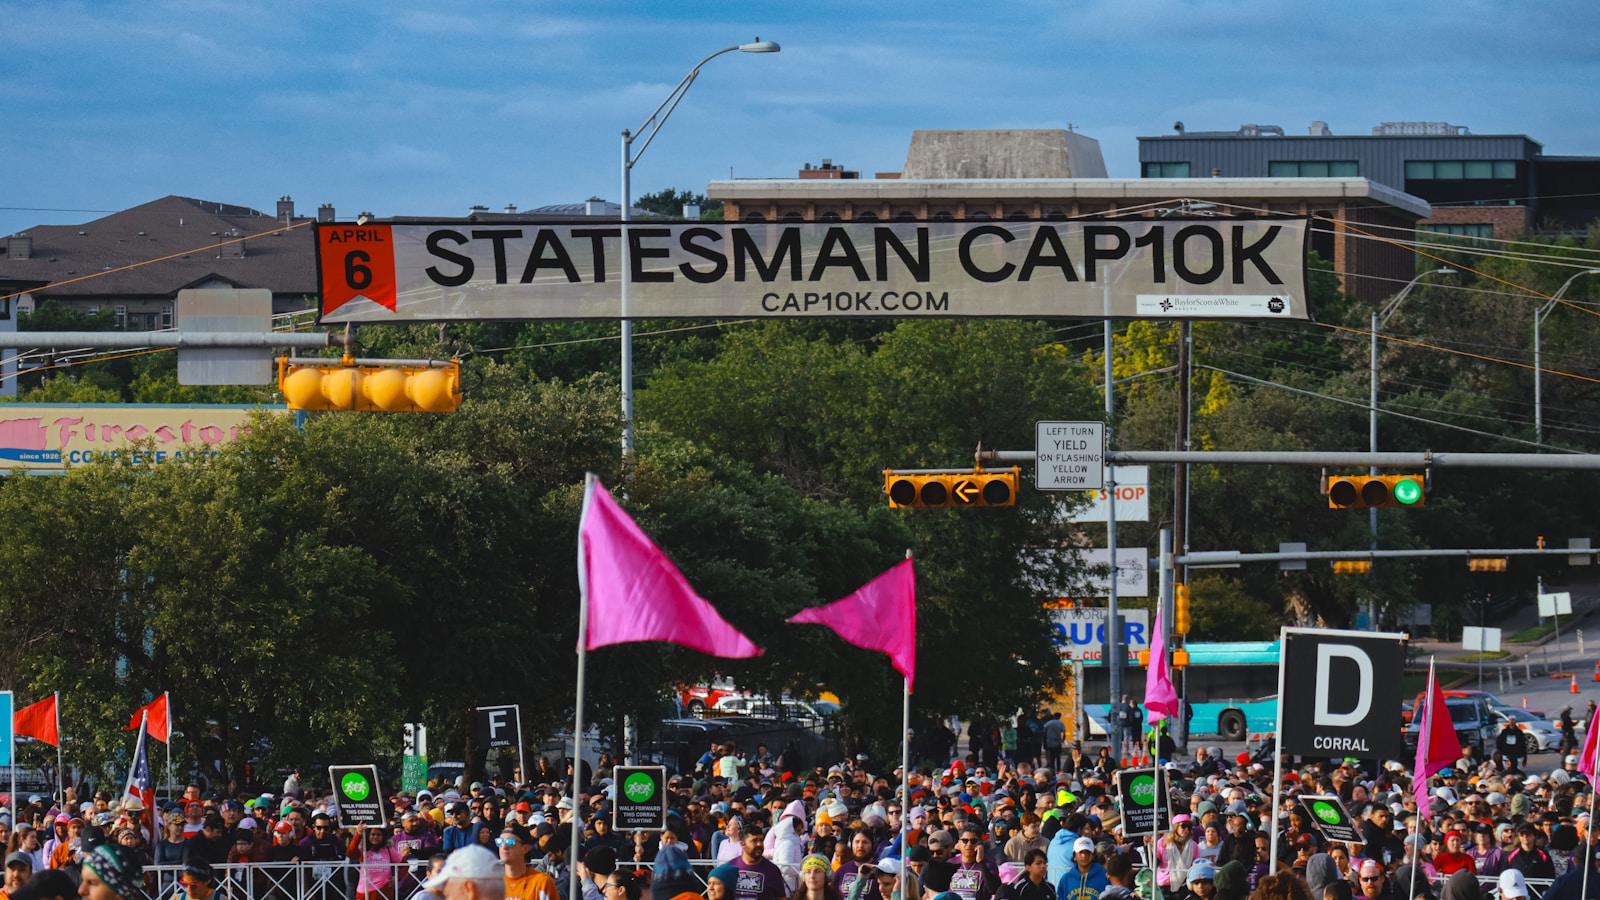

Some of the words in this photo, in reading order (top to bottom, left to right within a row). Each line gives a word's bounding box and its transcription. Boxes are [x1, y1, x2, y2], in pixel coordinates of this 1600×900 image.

[328, 228, 385, 244] APRIL
[424, 226, 931, 287] STATESMAN
[958, 223, 1285, 286] CAP10K
[344, 249, 373, 291] 6
[762, 291, 949, 313] CAP10K.COM
[1046, 427, 1067, 436] LEFT
[1071, 427, 1094, 436] TURN
[1053, 440, 1087, 451] YIELD
[1040, 453, 1053, 463] ON
[1056, 453, 1100, 463] FLASHING
[1052, 464, 1088, 474] YELLOW
[1053, 475, 1086, 485] ARROW
[1099, 487, 1145, 501] SHOP
[1071, 608, 1109, 619] WORL
[1313, 642, 1374, 727] D
[488, 709, 507, 740] F
[1313, 736, 1370, 752] CORRAL
